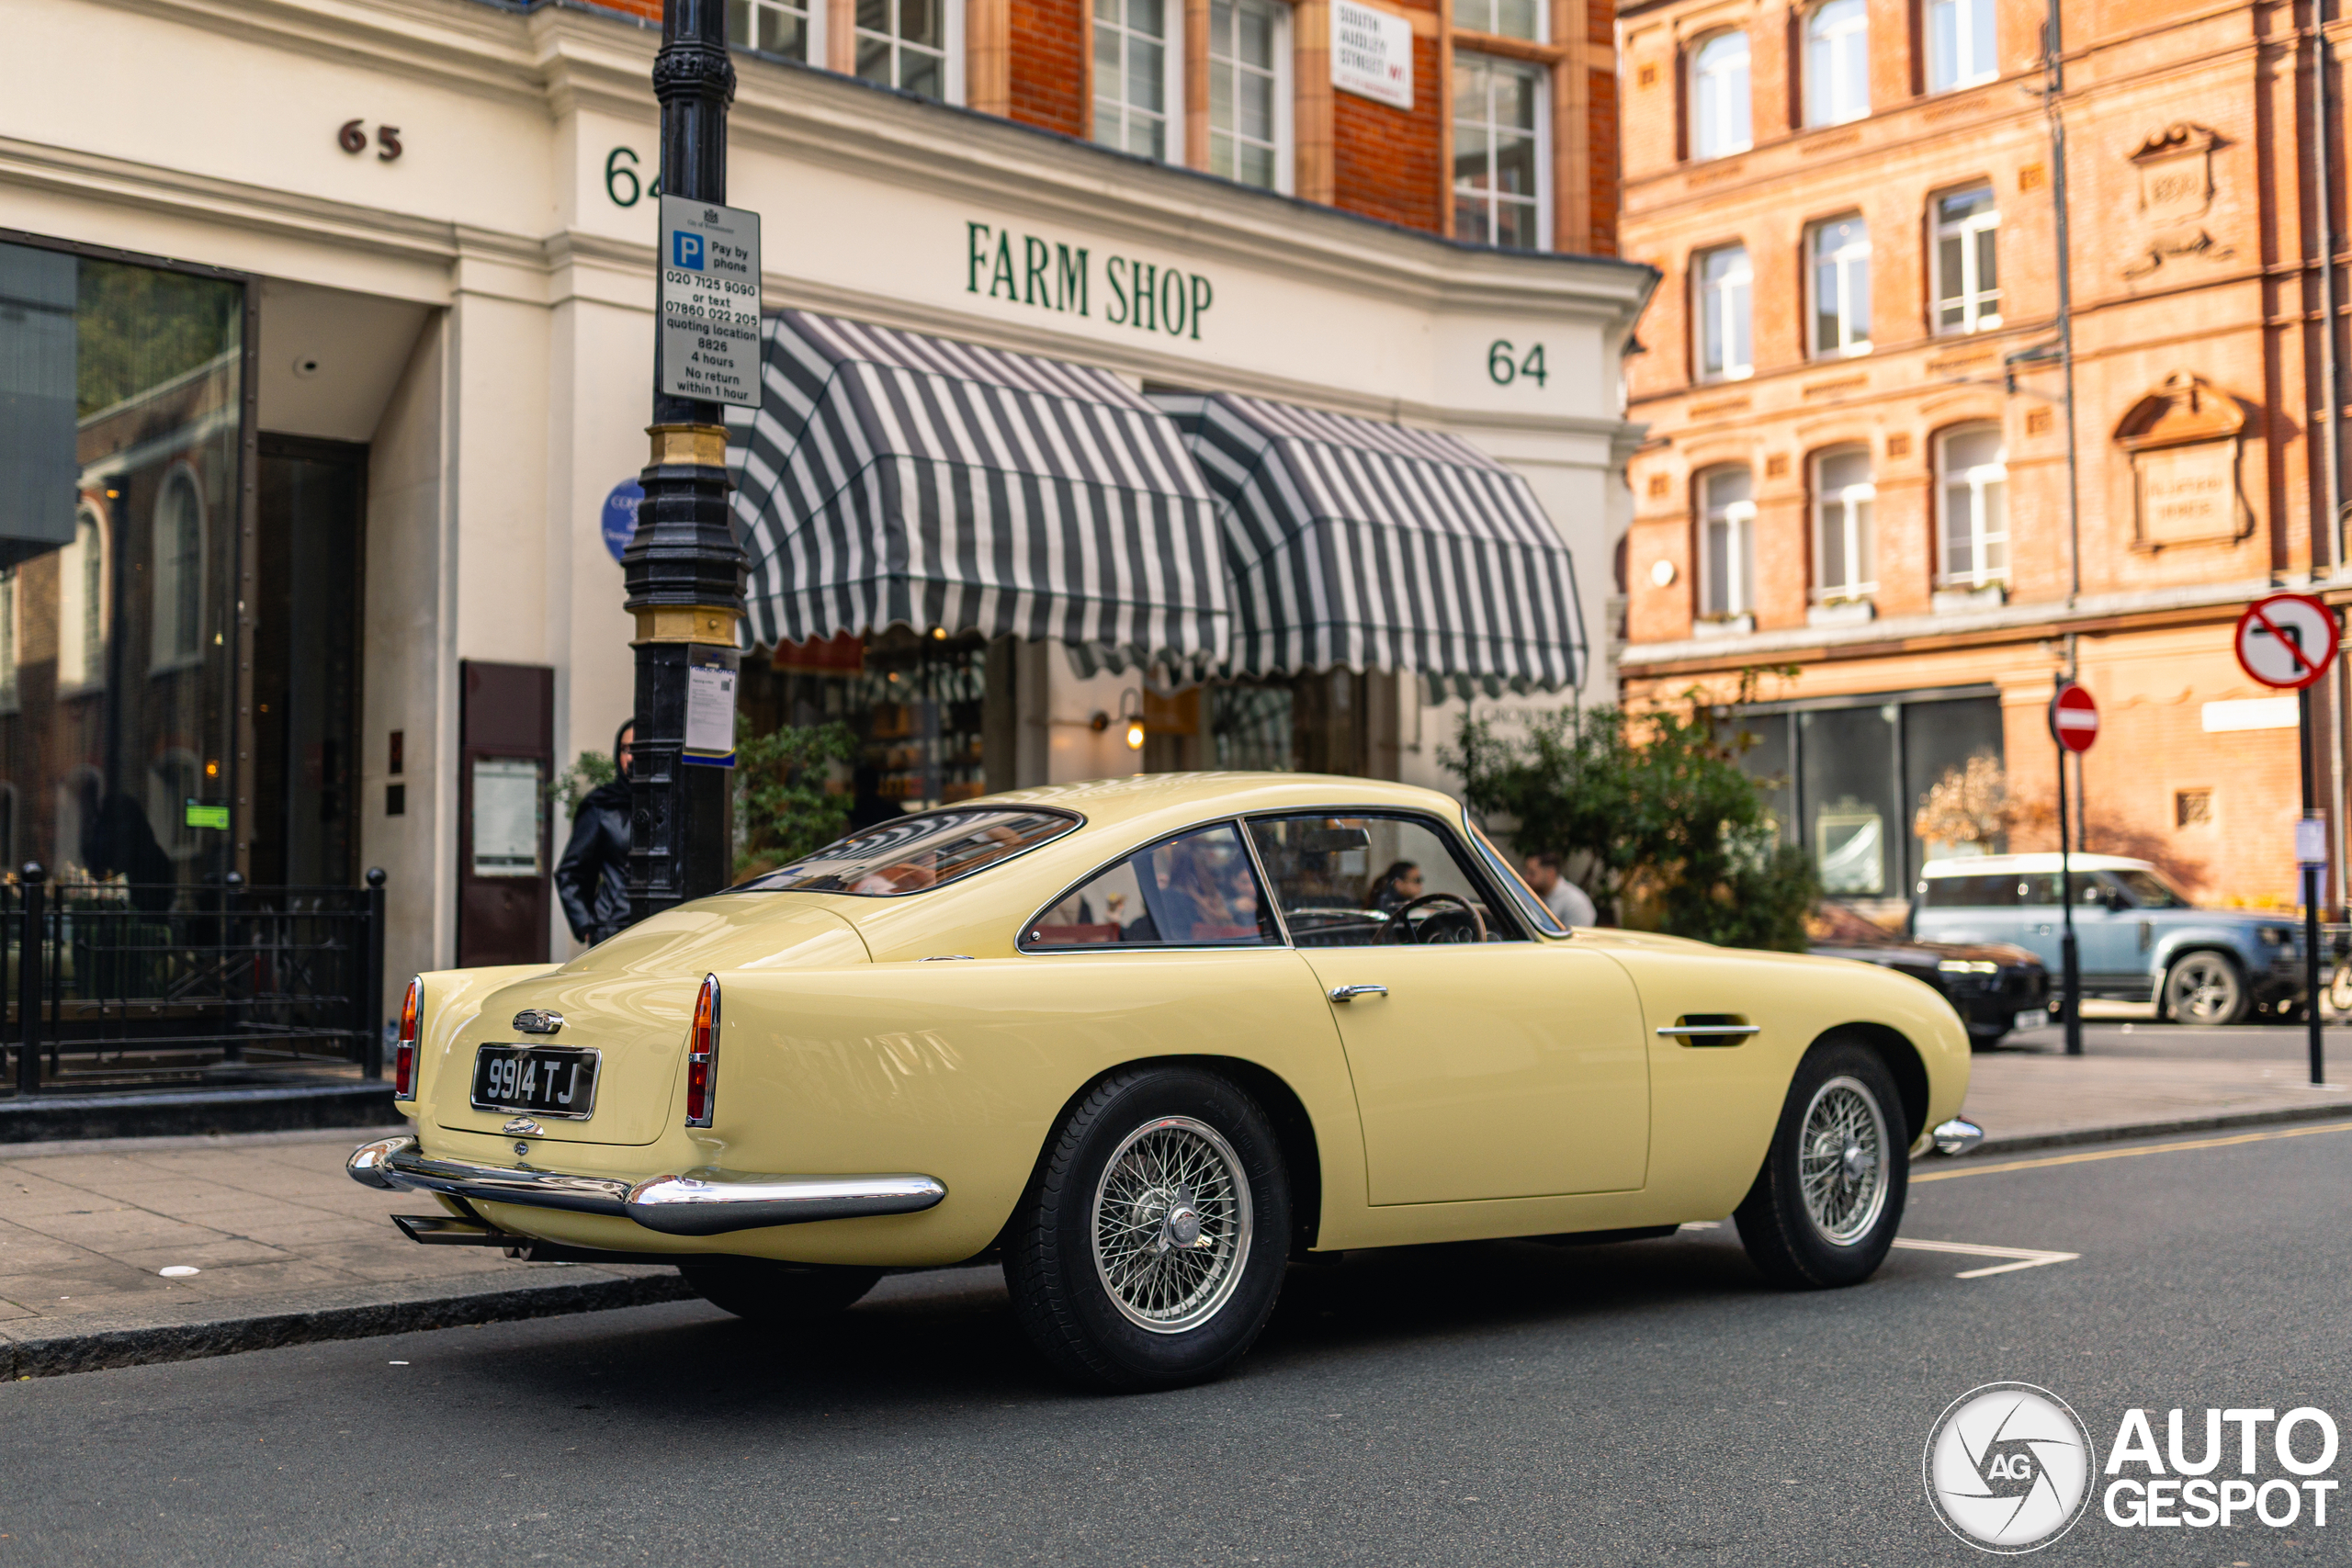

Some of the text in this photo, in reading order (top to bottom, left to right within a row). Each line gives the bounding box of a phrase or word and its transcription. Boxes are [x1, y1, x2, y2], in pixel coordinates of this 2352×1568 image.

[338, 118, 402, 162] 65
[681, 236, 699, 264] P
[711, 241, 748, 260] Pay by
[713, 258, 747, 273] phone
[666, 271, 755, 297] 020 7125 9090
[966, 220, 1213, 341] FARM SHOP
[693, 294, 730, 308] or text
[665, 300, 758, 326] 07860 022 205
[667, 318, 756, 341] quoting location
[697, 337, 728, 352] 8826
[691, 351, 734, 367] 4 hours
[1487, 339, 1549, 389] 64
[685, 367, 740, 385] No return
[677, 381, 748, 400] within 1 hour
[487, 1058, 579, 1104] 9914 TJ
